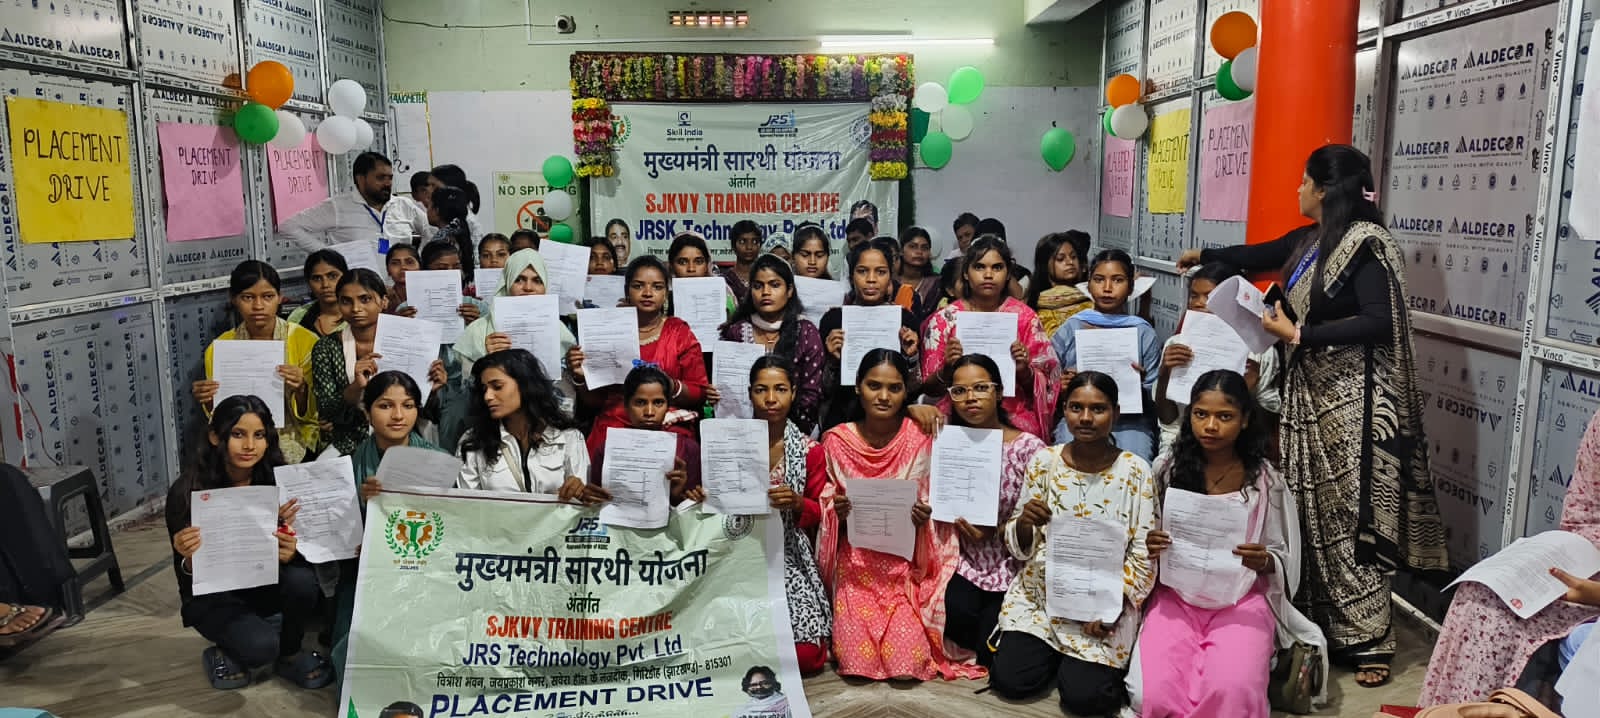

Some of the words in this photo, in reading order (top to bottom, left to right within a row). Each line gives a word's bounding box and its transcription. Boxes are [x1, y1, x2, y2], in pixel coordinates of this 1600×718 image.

[142, 14, 175, 30] ALDECOR
[1454, 8, 1470, 17] Vinco
[15, 33, 62, 50] ALDECOR
[188, 26, 217, 40] ALDECOR
[80, 44, 120, 60] ALDECOR
[1477, 42, 1534, 66] ALDECOR
[1411, 58, 1457, 76] ALDECOR
[1552, 50, 1562, 82] Vinco
[760, 114, 788, 126] JRS
[666, 128, 682, 136] Skill
[684, 128, 703, 136] India
[1208, 124, 1250, 151] PLACEMEN
[24, 128, 122, 164] PLACEMENT
[1405, 141, 1450, 155] ALDECOR
[1468, 136, 1524, 152] ALDECOR
[178, 146, 232, 166] PLACEMENT
[274, 150, 321, 171] PLACEMENT
[644, 144, 720, 178] मुख्यमंत्री
[724, 144, 778, 172] सारथी
[784, 144, 840, 172] योजना
[1215, 152, 1248, 178] DRIVE
[1542, 142, 1552, 174] Vinco
[48, 174, 110, 204] DRIVE
[192, 170, 218, 186] DRIVE
[288, 175, 312, 194] DRIVE
[728, 174, 756, 189] अंतर्गत
[498, 186, 516, 196] NO
[520, 186, 576, 196] SPITG
[646, 193, 699, 214] SJKVY
[705, 193, 777, 214] TRAINING
[781, 193, 840, 213] CENTRE
[0, 183, 14, 252] ALDECOR
[1400, 218, 1442, 232] ALDECOR
[636, 220, 676, 240] JRSK
[683, 219, 777, 243] Techngy
[1462, 222, 1515, 238] ALDECOR
[176, 252, 206, 263] ALDECOR
[1533, 232, 1542, 262] Vinco
[1410, 296, 1436, 312] ECOR
[1454, 306, 1507, 326] ALDECOR
[169, 312, 178, 368] ALDECOR
[1524, 319, 1533, 349] Vinco
[124, 332, 137, 397] ALDECOR
[1543, 348, 1564, 362] Vinco
[87, 340, 100, 402] ALDECOR
[43, 350, 59, 421] ALDECOR
[1436, 396, 1488, 424] ALDECOR
[1515, 404, 1524, 433] Vinco
[132, 416, 144, 480] ALDECOR
[1506, 487, 1515, 516] Vinco
[568, 517, 600, 534] JRS
[456, 546, 561, 592] मुख्यमंत्री
[565, 548, 632, 585] सारथी
[638, 550, 708, 585] योजना
[566, 592, 600, 614] अंतर्गत
[486, 616, 542, 639] SJKVY
[547, 618, 615, 640] TRAINING
[619, 611, 672, 638] CENTRE
[462, 642, 502, 666] JRS
[508, 644, 611, 669] Technology
[654, 634, 682, 657] Ltd
[632, 666, 661, 680] गिरिडीह
[705, 656, 732, 671] 815301
[429, 688, 617, 718] PLACEMENT
[627, 676, 714, 704] DRIVE
